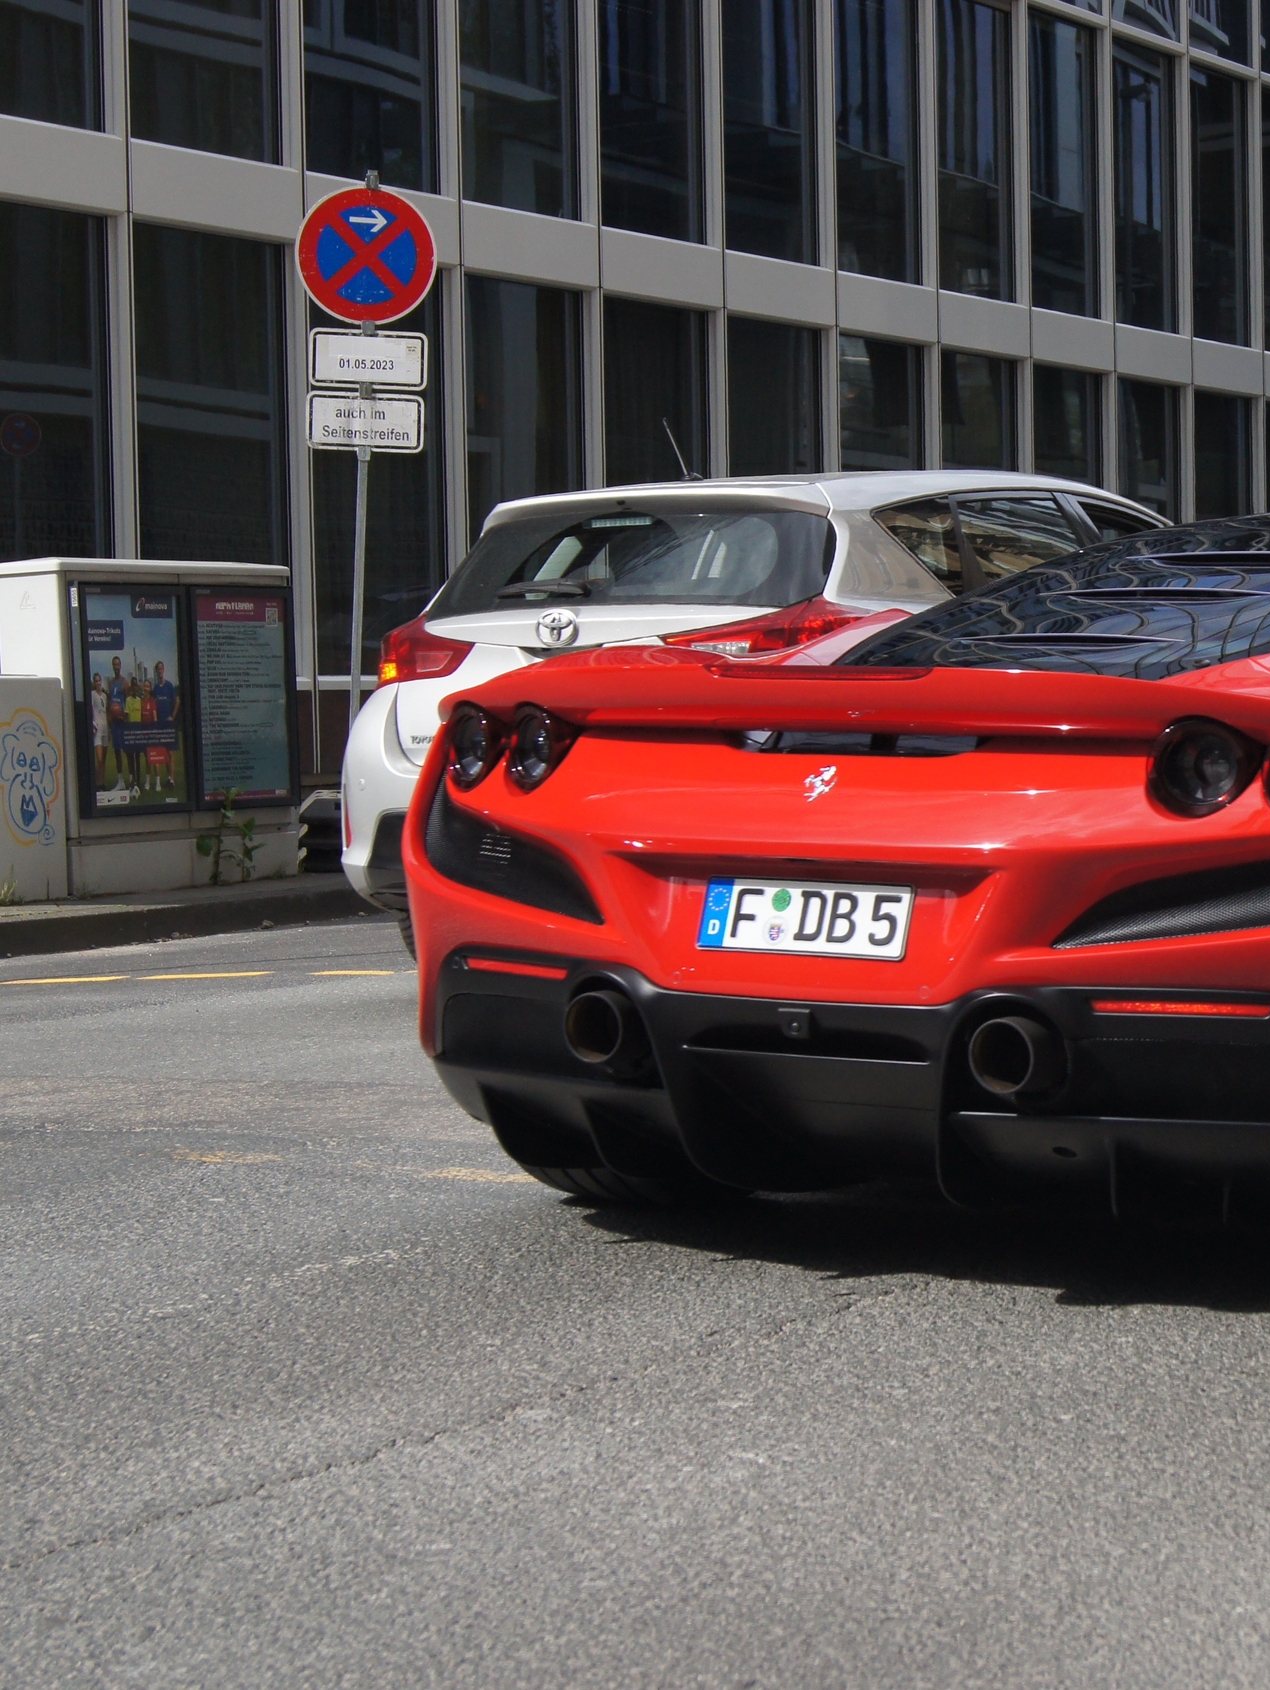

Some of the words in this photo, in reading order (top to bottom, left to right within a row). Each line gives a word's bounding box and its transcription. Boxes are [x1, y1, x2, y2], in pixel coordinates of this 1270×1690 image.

[339, 358, 395, 371] 01.05.2023
[335, 407, 367, 419] auch
[371, 407, 386, 420] im
[322, 424, 410, 442] Seitenstreifen
[145, 602, 168, 610] mainova
[730, 888, 765, 938] F
[793, 889, 860, 944] DB
[868, 893, 903, 947] 5
[706, 919, 721, 935] D
